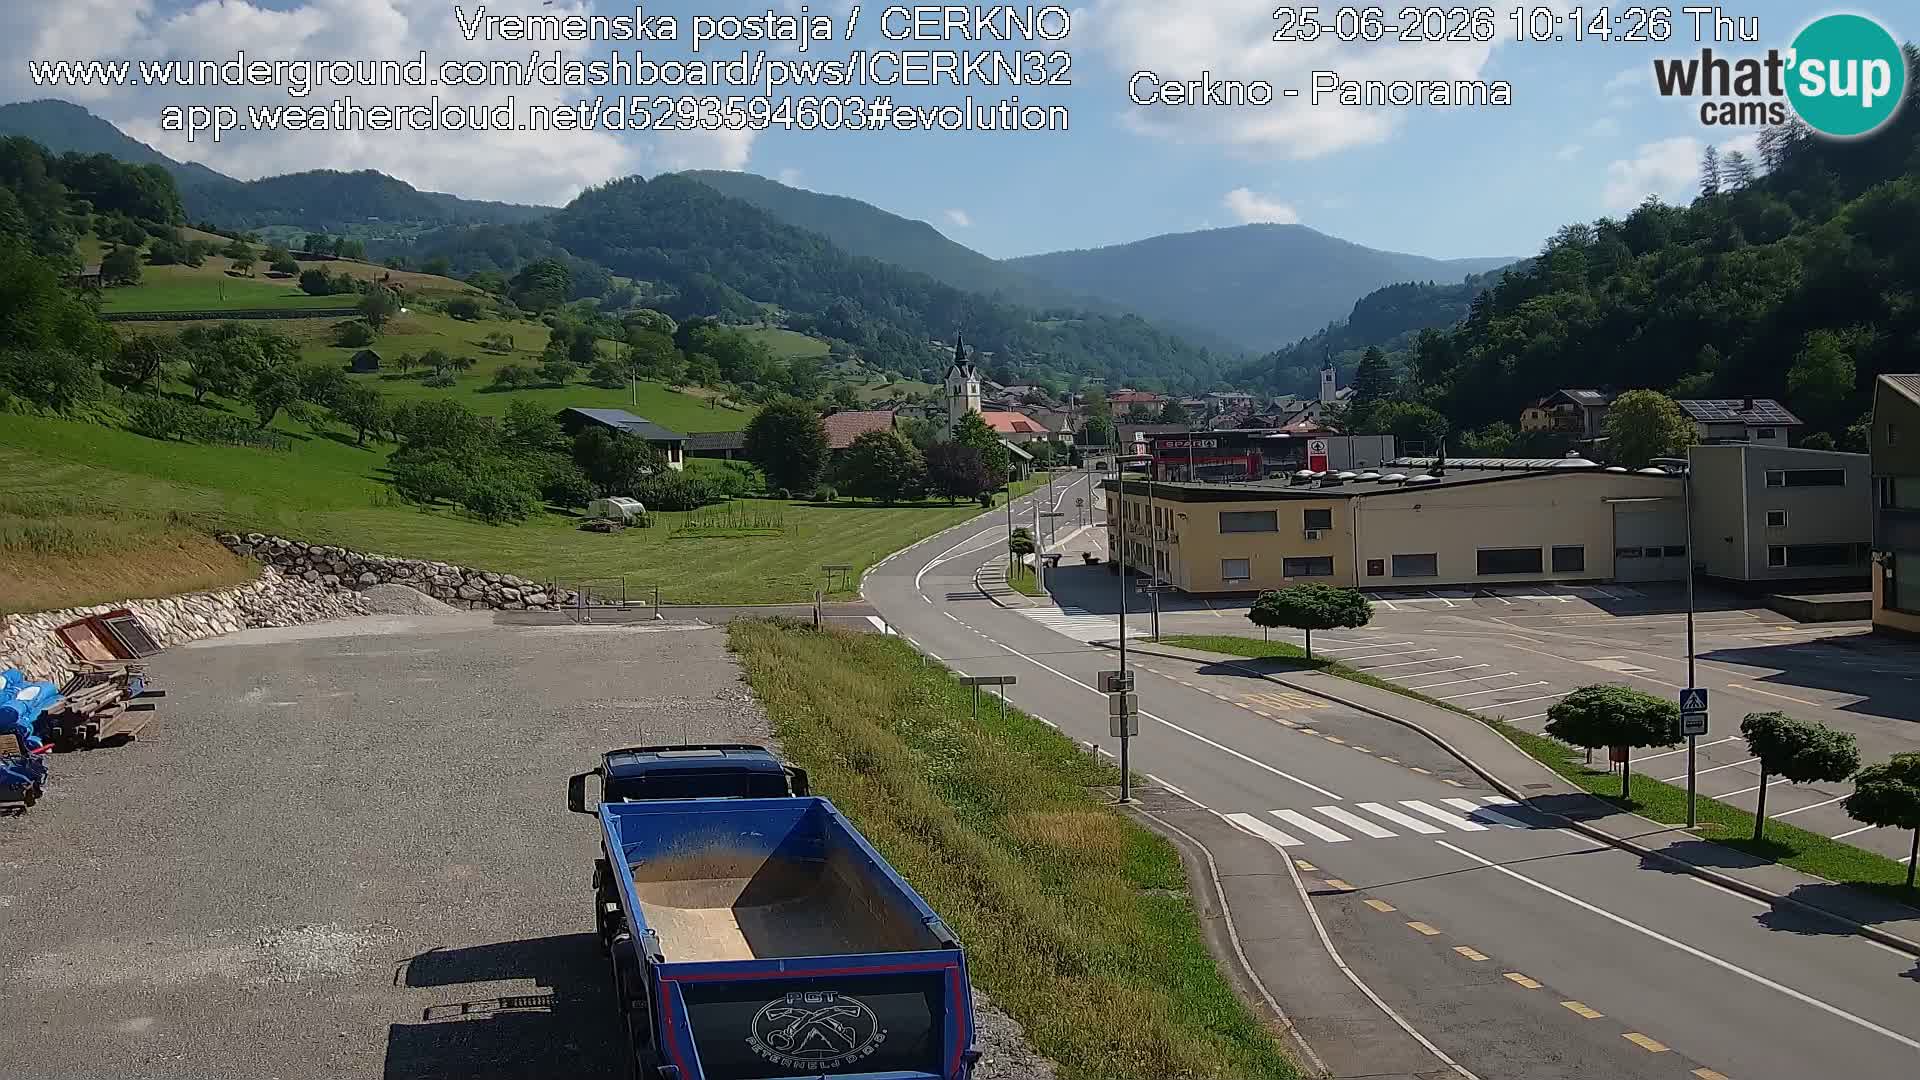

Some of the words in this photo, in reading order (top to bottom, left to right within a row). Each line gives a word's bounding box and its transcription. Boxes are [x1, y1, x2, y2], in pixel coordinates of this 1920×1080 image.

[1166, 440, 1204, 449] SPAR
[786, 991, 838, 1004] PGT
[745, 1035, 841, 1070] PETERNELJ
